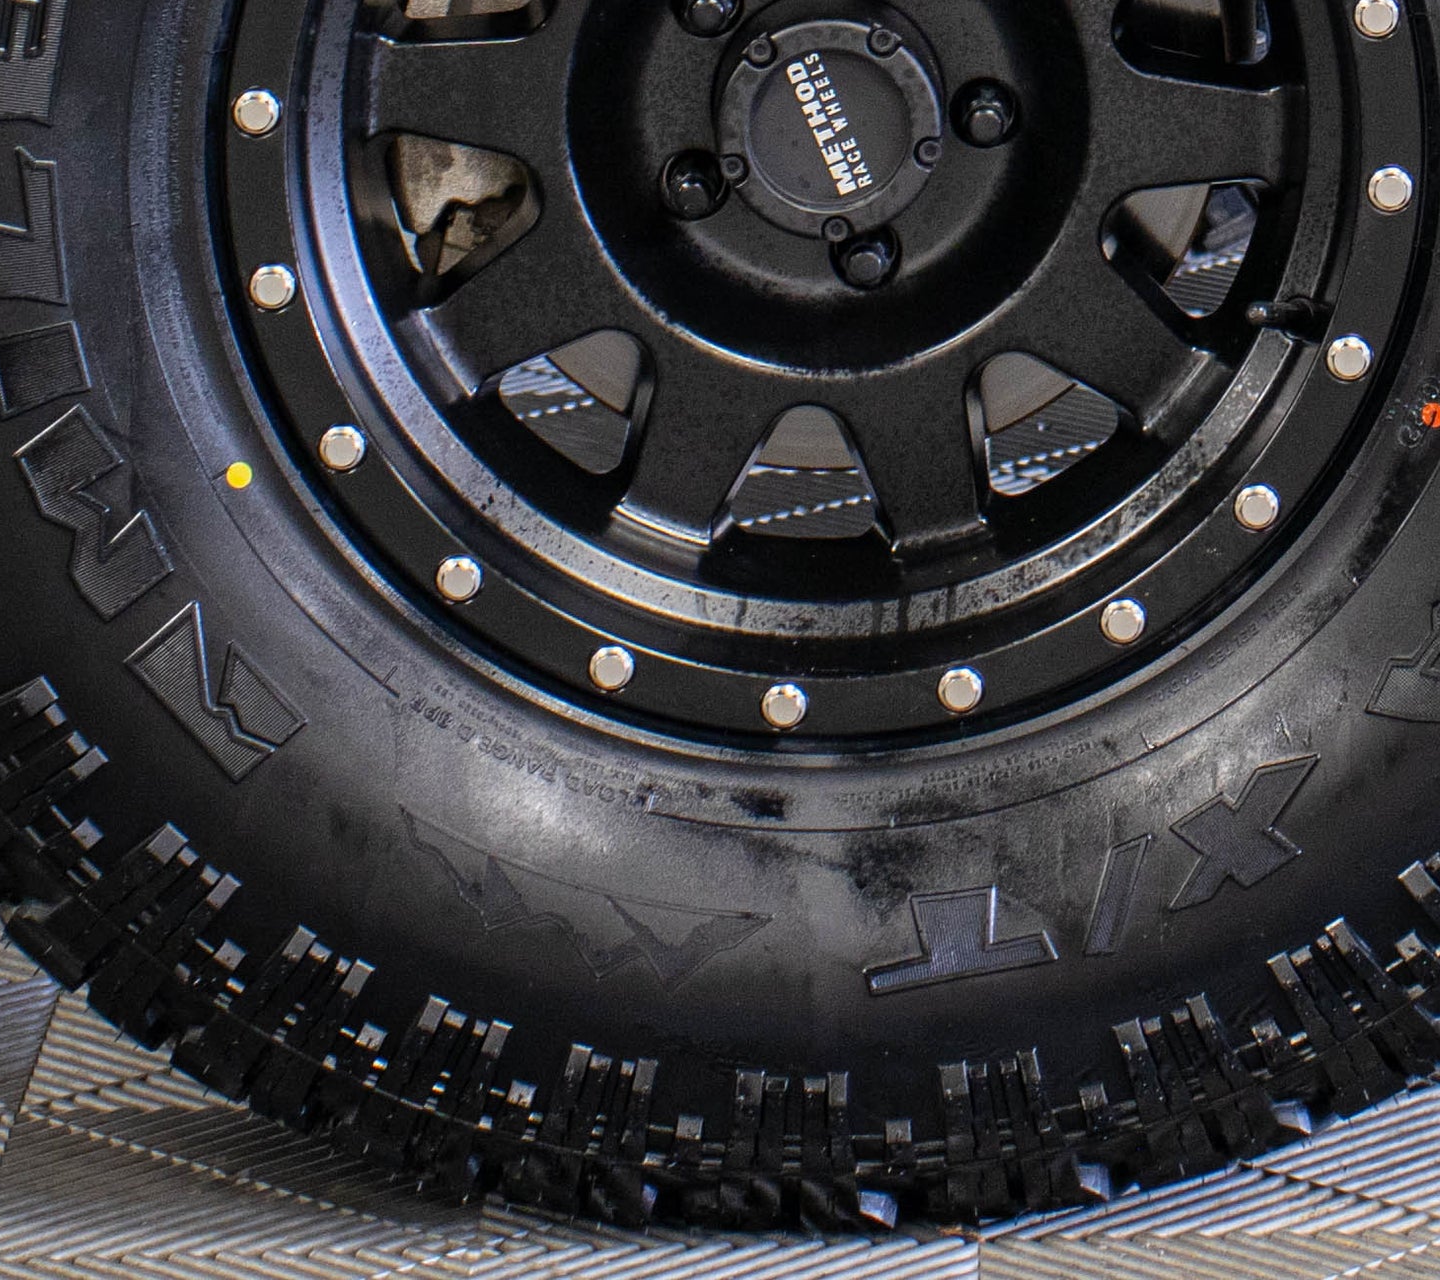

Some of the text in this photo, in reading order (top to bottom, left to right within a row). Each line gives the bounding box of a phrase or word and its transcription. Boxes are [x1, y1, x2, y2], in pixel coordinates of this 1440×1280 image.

[786, 60, 858, 197] METHOD
[804, 52, 874, 190] RACE WHEELS
